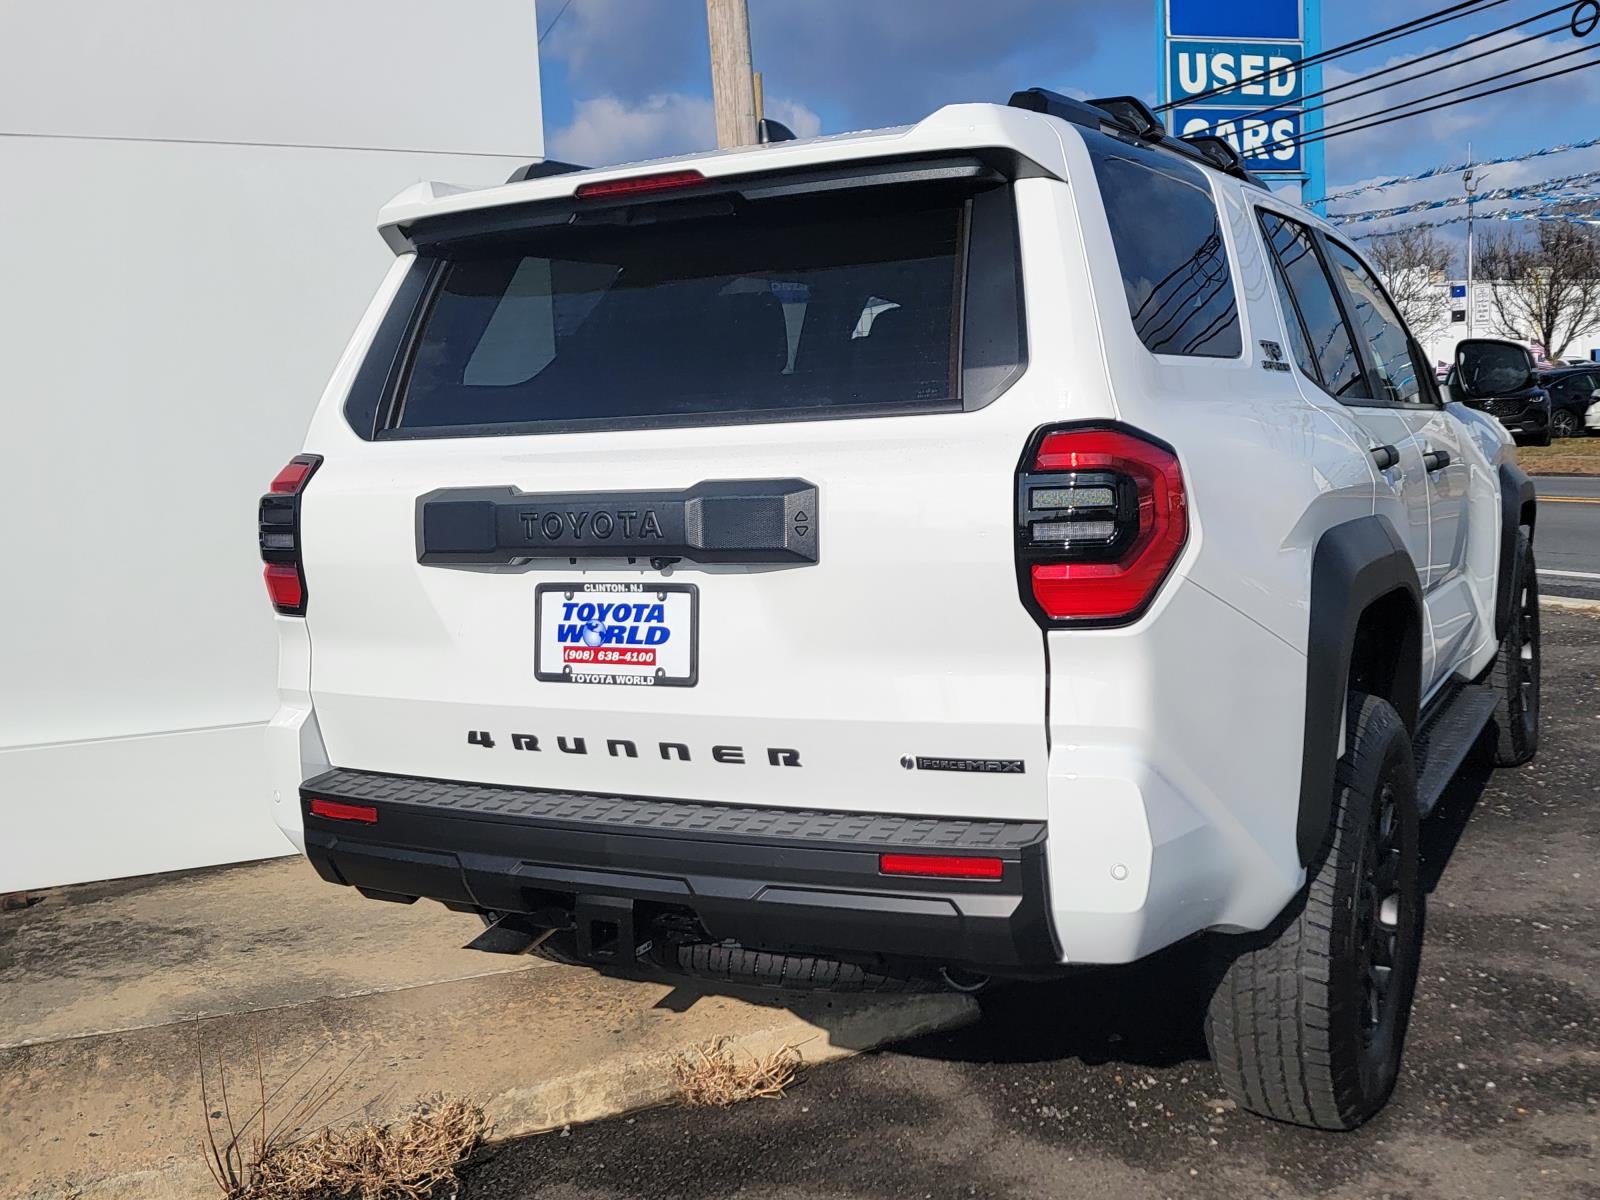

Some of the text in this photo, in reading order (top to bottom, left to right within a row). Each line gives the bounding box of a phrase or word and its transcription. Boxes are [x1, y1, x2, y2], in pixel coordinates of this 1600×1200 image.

[1178, 52, 1296, 97] USED
[518, 510, 664, 540] TOYOTA
[630, 584, 643, 592] NJ
[562, 602, 665, 623] TOYOTA
[565, 649, 653, 662] (908) 638-4100
[570, 673, 655, 685] TOYOTA WORLD
